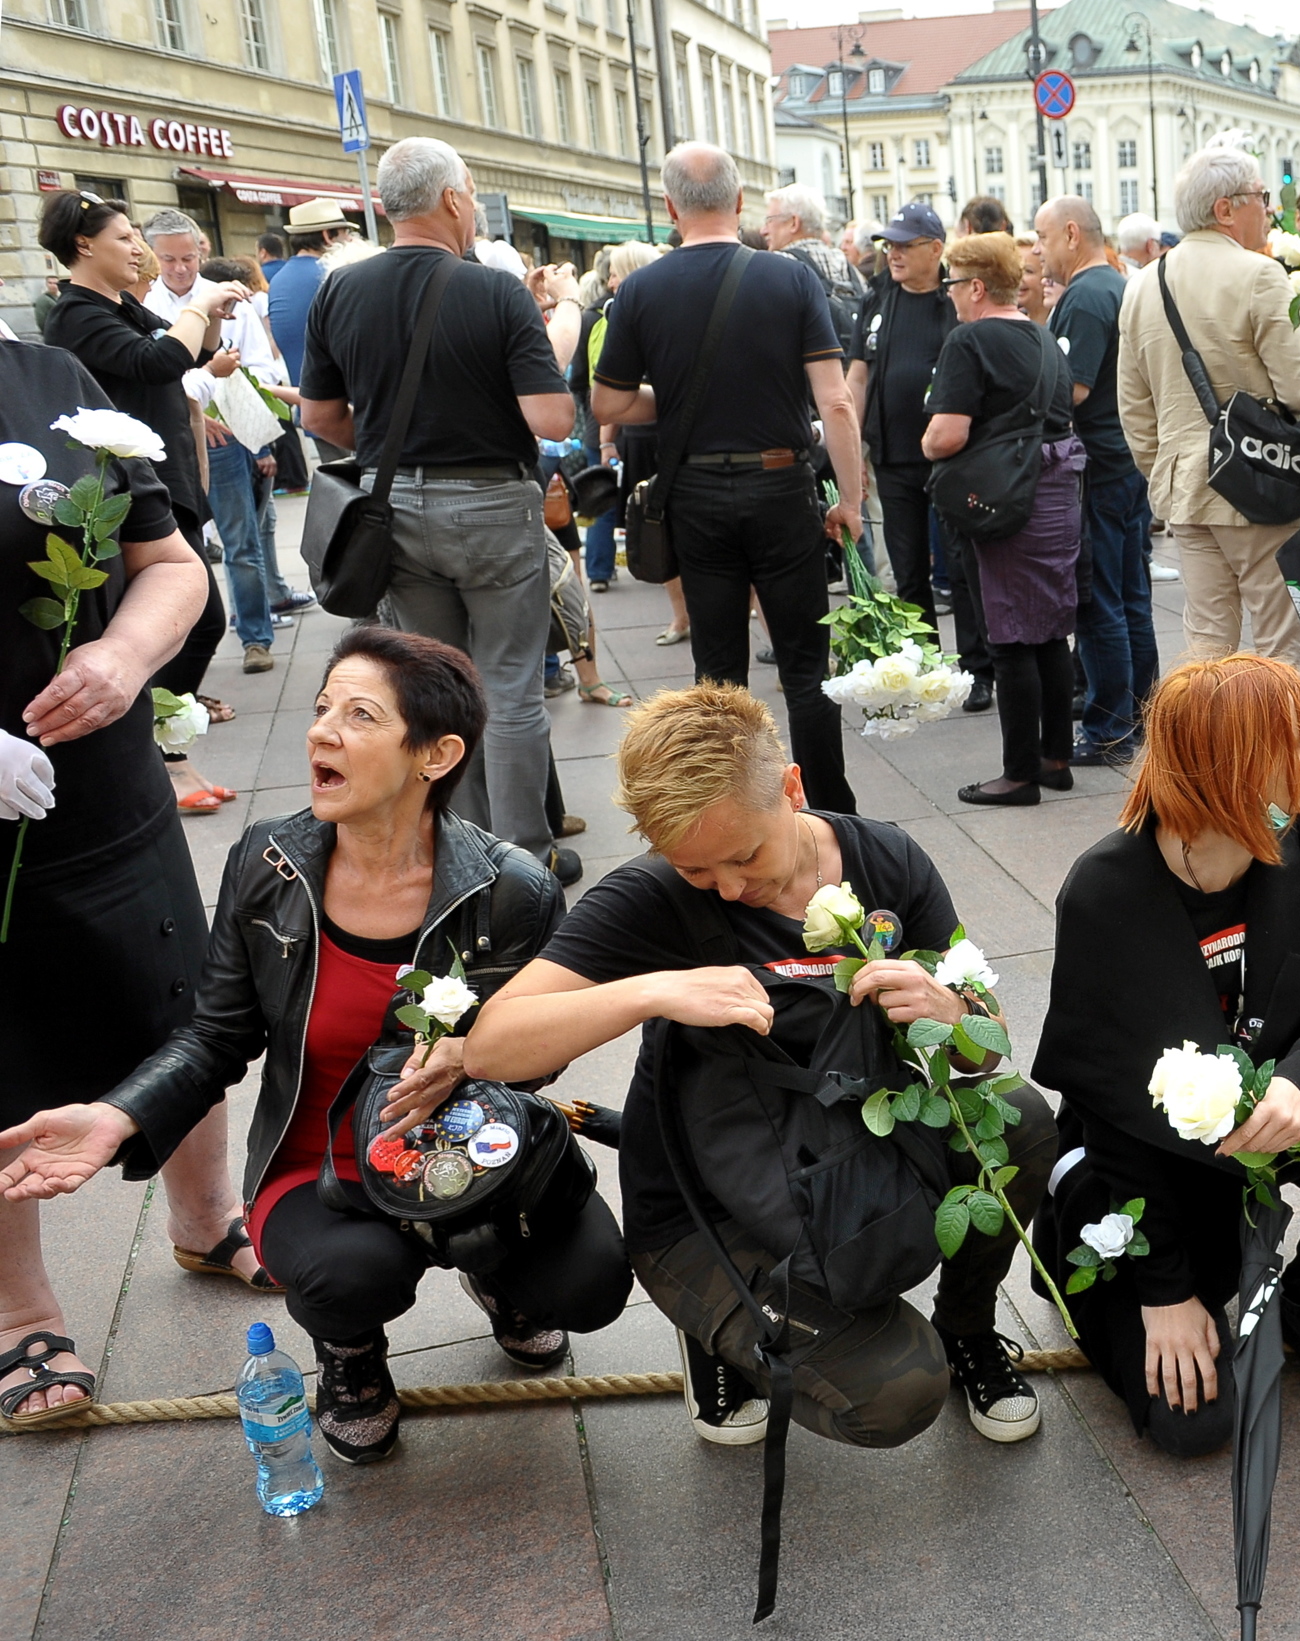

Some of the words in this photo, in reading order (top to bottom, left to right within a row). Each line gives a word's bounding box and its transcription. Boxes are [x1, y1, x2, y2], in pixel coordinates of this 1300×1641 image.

[57, 104, 146, 147] COSTA
[148, 118, 234, 158] COFFEE
[1201, 931, 1246, 957] ZYNARODO
